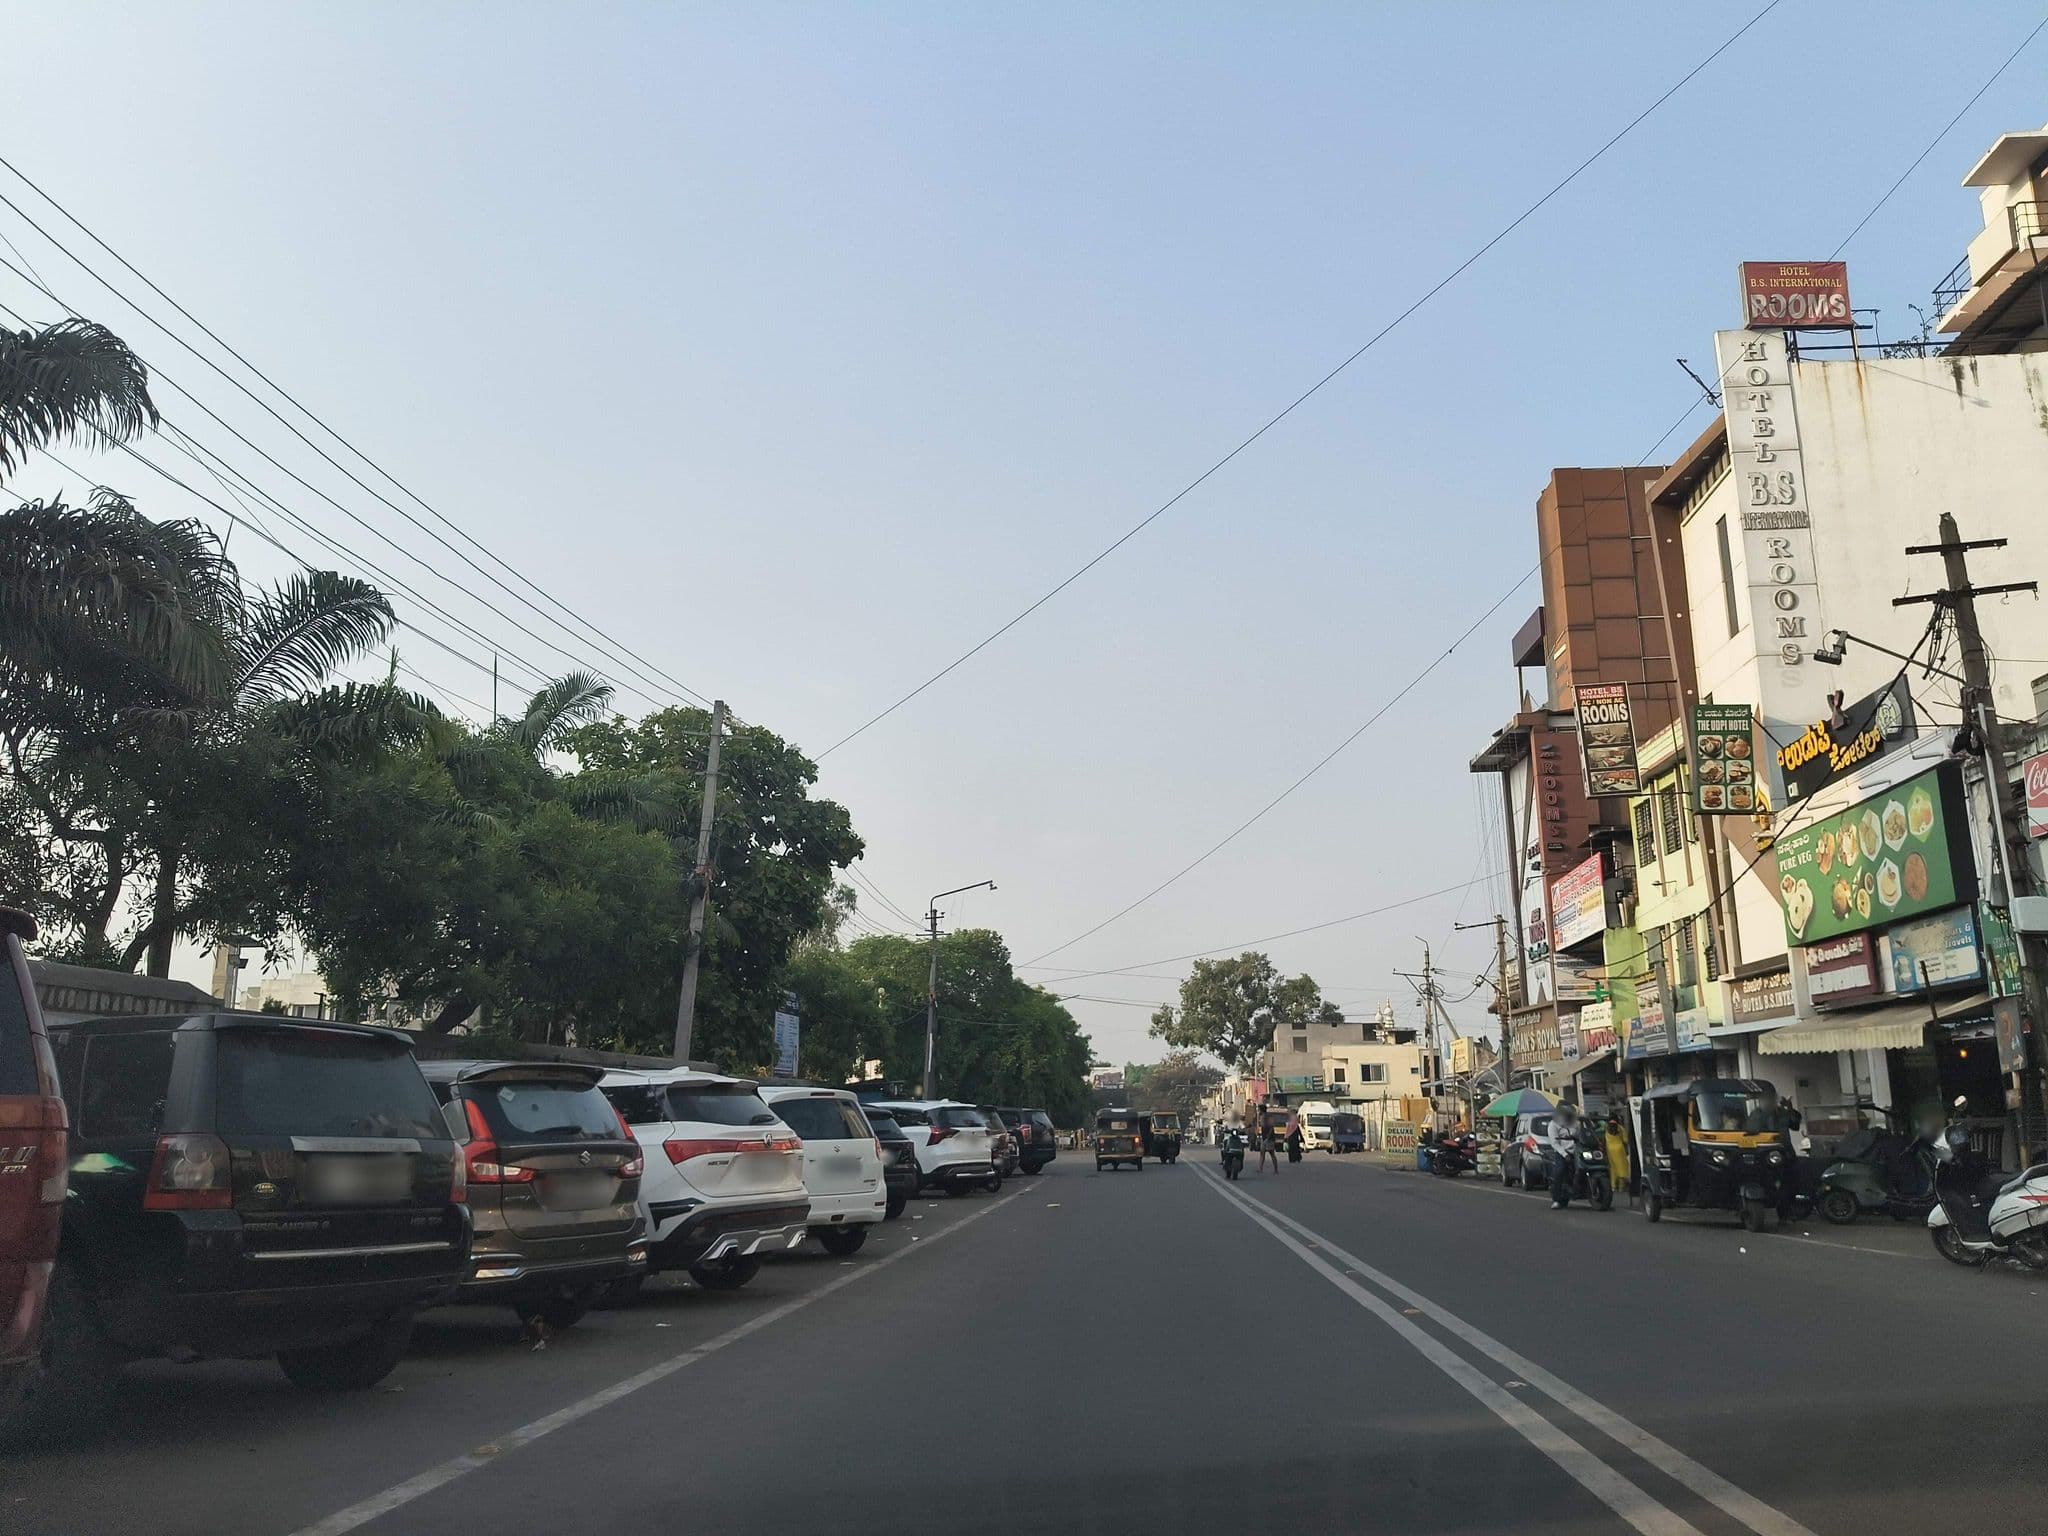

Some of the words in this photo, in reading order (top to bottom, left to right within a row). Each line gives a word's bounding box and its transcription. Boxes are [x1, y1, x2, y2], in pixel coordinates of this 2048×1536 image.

[1780, 267, 1810, 276] HOTEL
[1750, 278, 1768, 287] B.S.
[1770, 278, 1842, 288] INTERNATIONAL
[1750, 293, 1846, 319] ROOMS
[1741, 340, 1776, 463] HOTEL
[1740, 510, 1810, 529] INTERNATIONAL
[1766, 537, 1807, 665] ROOMS
[1579, 687, 1609, 696] HOTEL
[1581, 703, 1629, 724] ROOMS
[1697, 720, 1711, 731] THE
[1729, 720, 1749, 731] HOTEL
[1784, 719, 1831, 771] ಉಡುಪಿ
[1779, 856, 1798, 873] PURE
[1798, 850, 1812, 866] VEG
[1536, 1027, 1560, 1050] ROYAL
[1387, 1127, 1414, 1135] DELUXE
[1386, 1135, 1416, 1148] ROOMS
